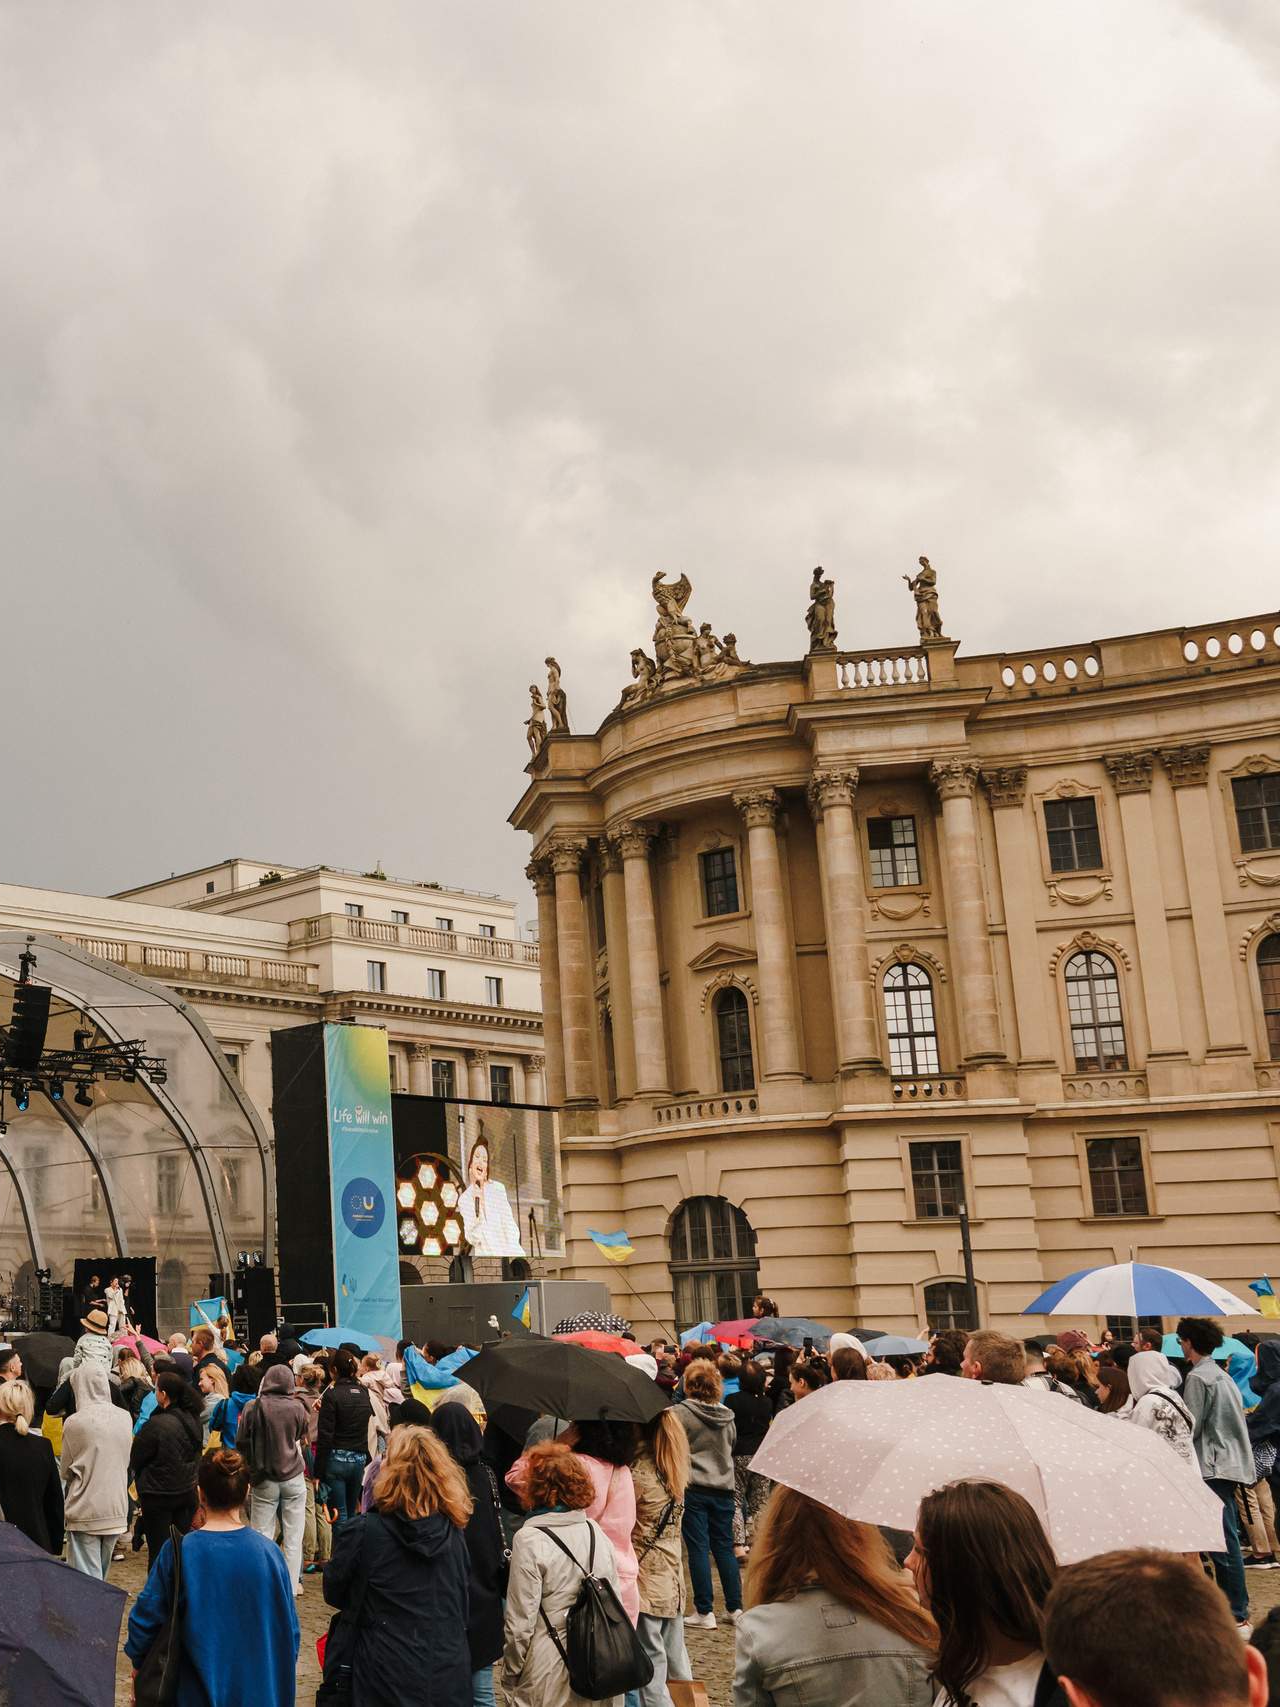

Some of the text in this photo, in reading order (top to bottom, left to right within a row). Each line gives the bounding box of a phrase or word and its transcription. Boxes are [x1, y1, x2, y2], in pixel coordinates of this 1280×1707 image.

[334, 1106, 388, 1124] Life will win
